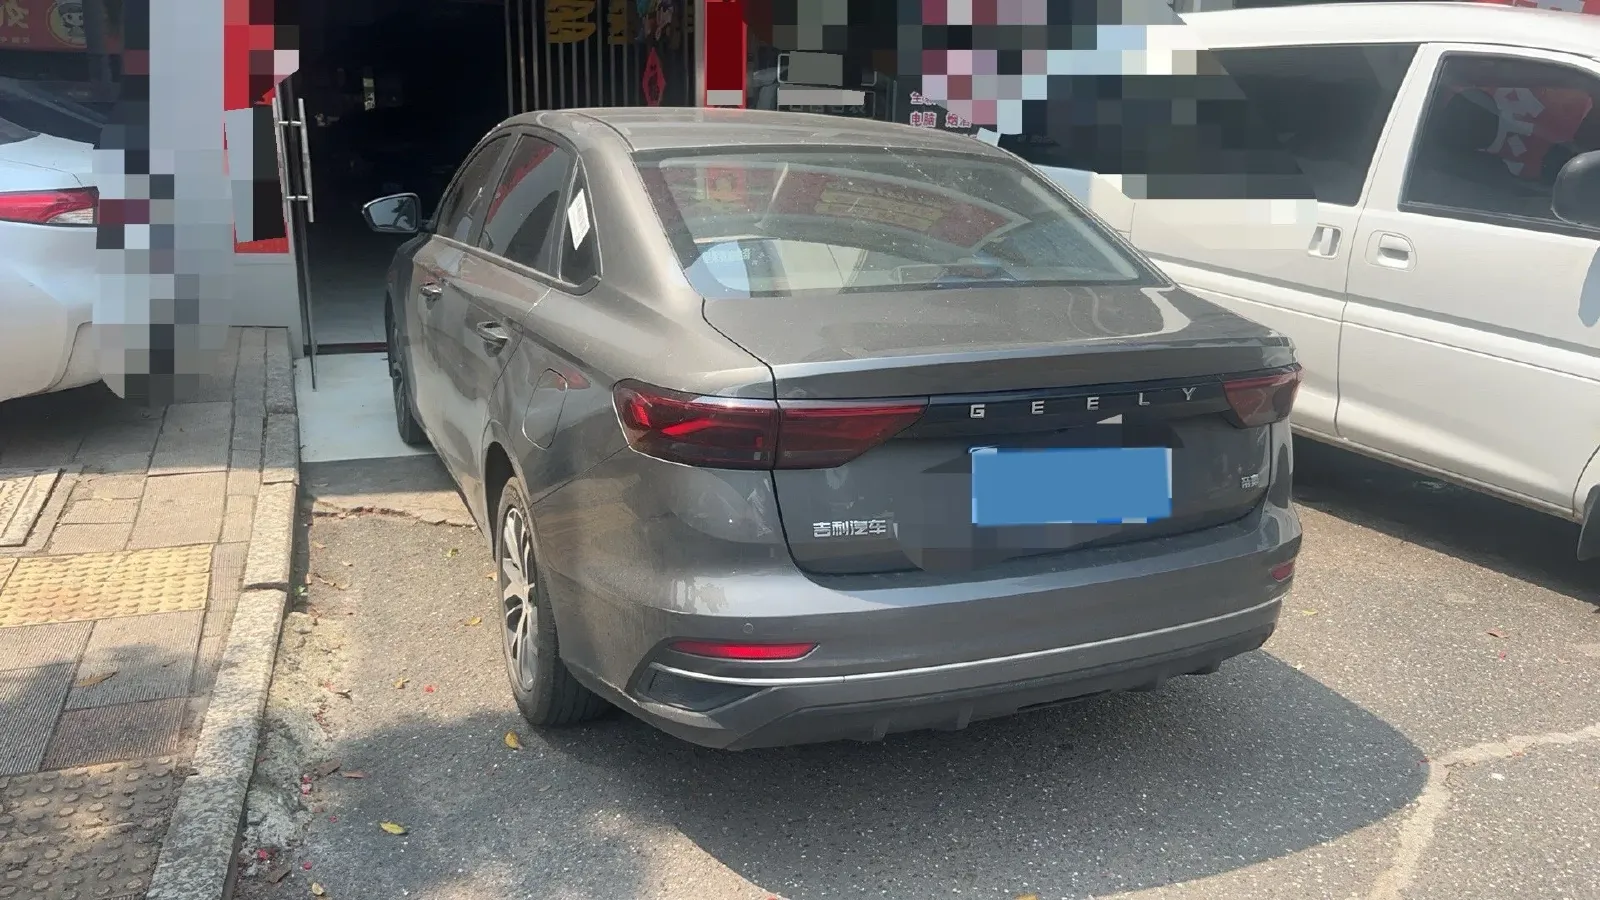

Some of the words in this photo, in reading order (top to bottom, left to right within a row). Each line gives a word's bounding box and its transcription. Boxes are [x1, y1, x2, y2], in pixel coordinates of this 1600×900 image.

[910, 111, 937, 127] 电脑
[969, 386, 1198, 419] GEELY
[812, 519, 887, 538] 吉利汽车
